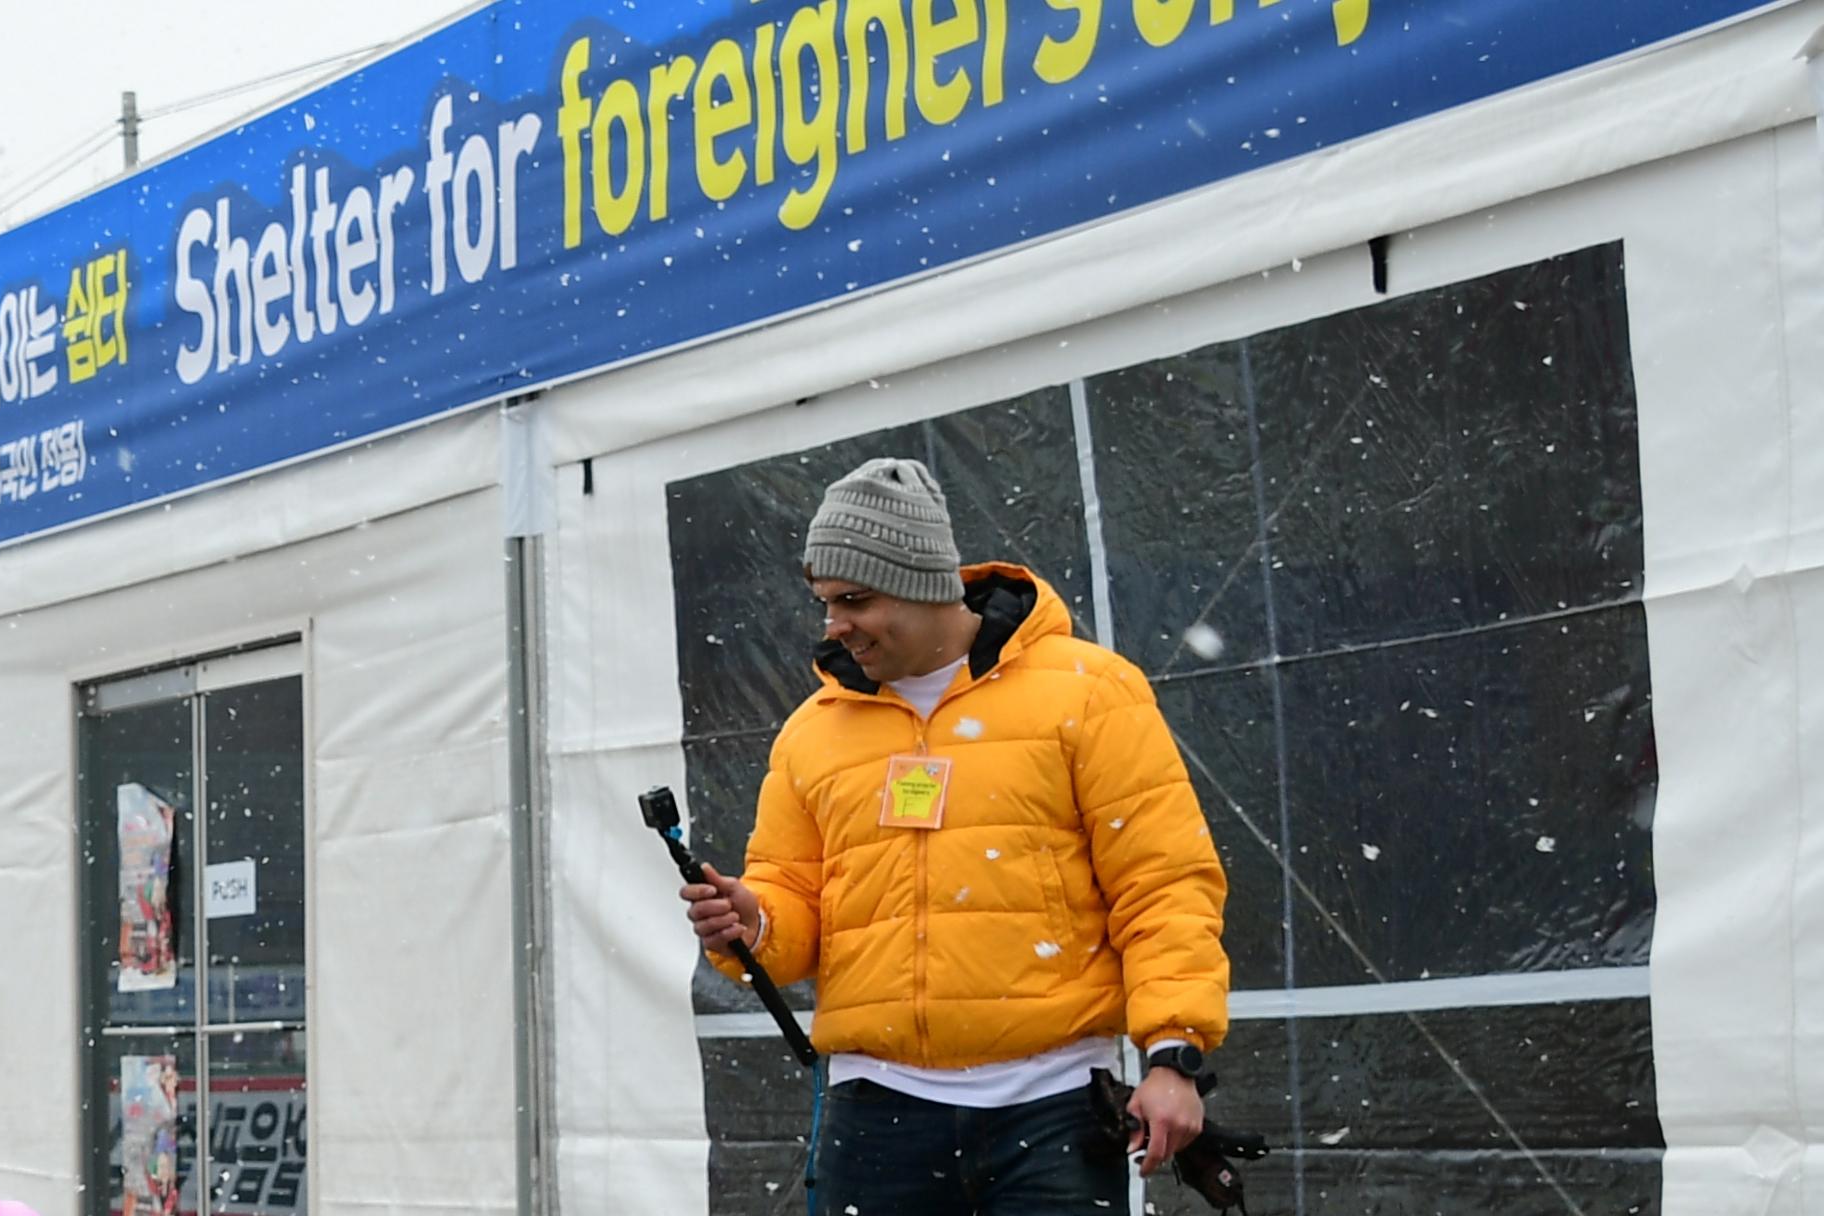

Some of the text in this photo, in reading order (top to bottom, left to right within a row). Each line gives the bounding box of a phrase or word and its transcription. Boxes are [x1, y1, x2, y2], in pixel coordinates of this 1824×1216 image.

[174, 163, 414, 385] Shelter
[424, 93, 541, 296] for
[63, 249, 128, 384] 쉼터
[211, 878, 249, 901] PUSH
